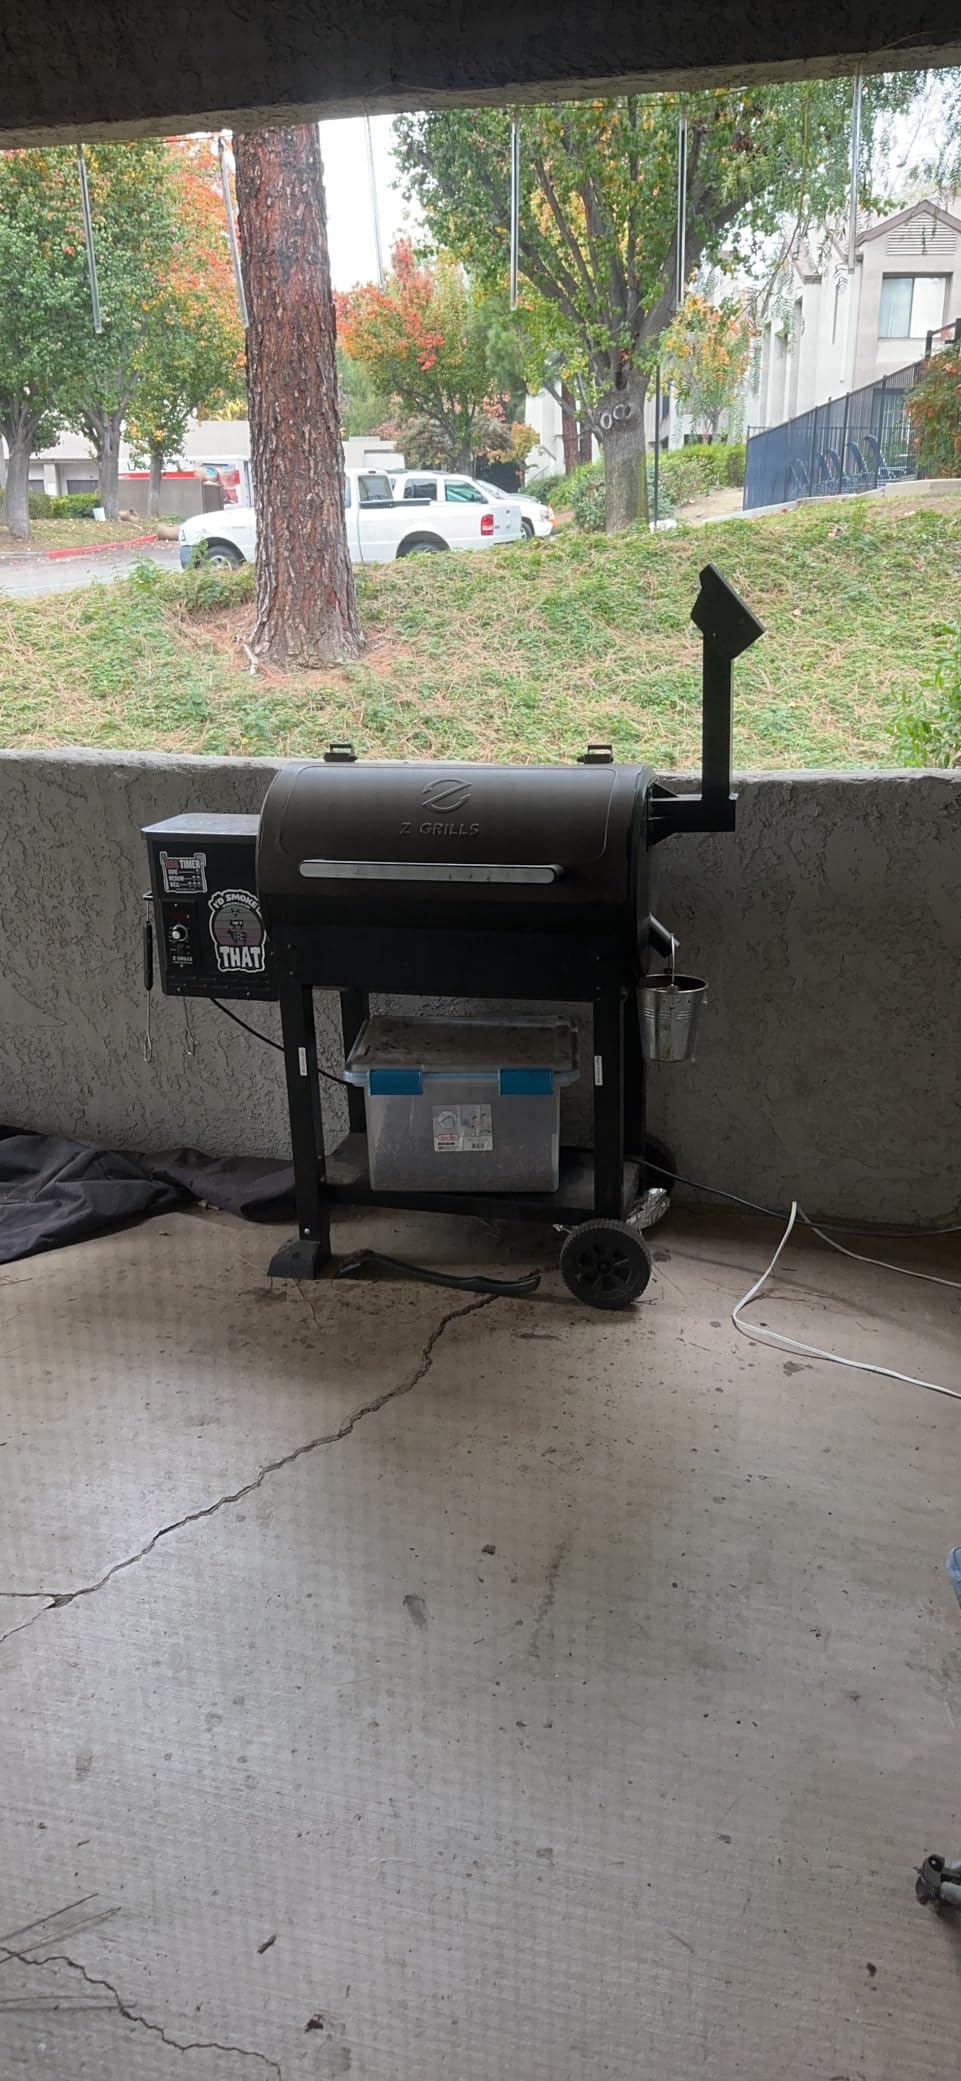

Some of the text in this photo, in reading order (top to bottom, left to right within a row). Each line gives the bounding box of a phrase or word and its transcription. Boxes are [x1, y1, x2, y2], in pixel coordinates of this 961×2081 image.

[400, 822, 480, 836] Z GRILLS
[179, 859, 201, 869] TIMER
[212, 894, 258, 909] I'D SMOKE
[219, 946, 261, 969] THAT
